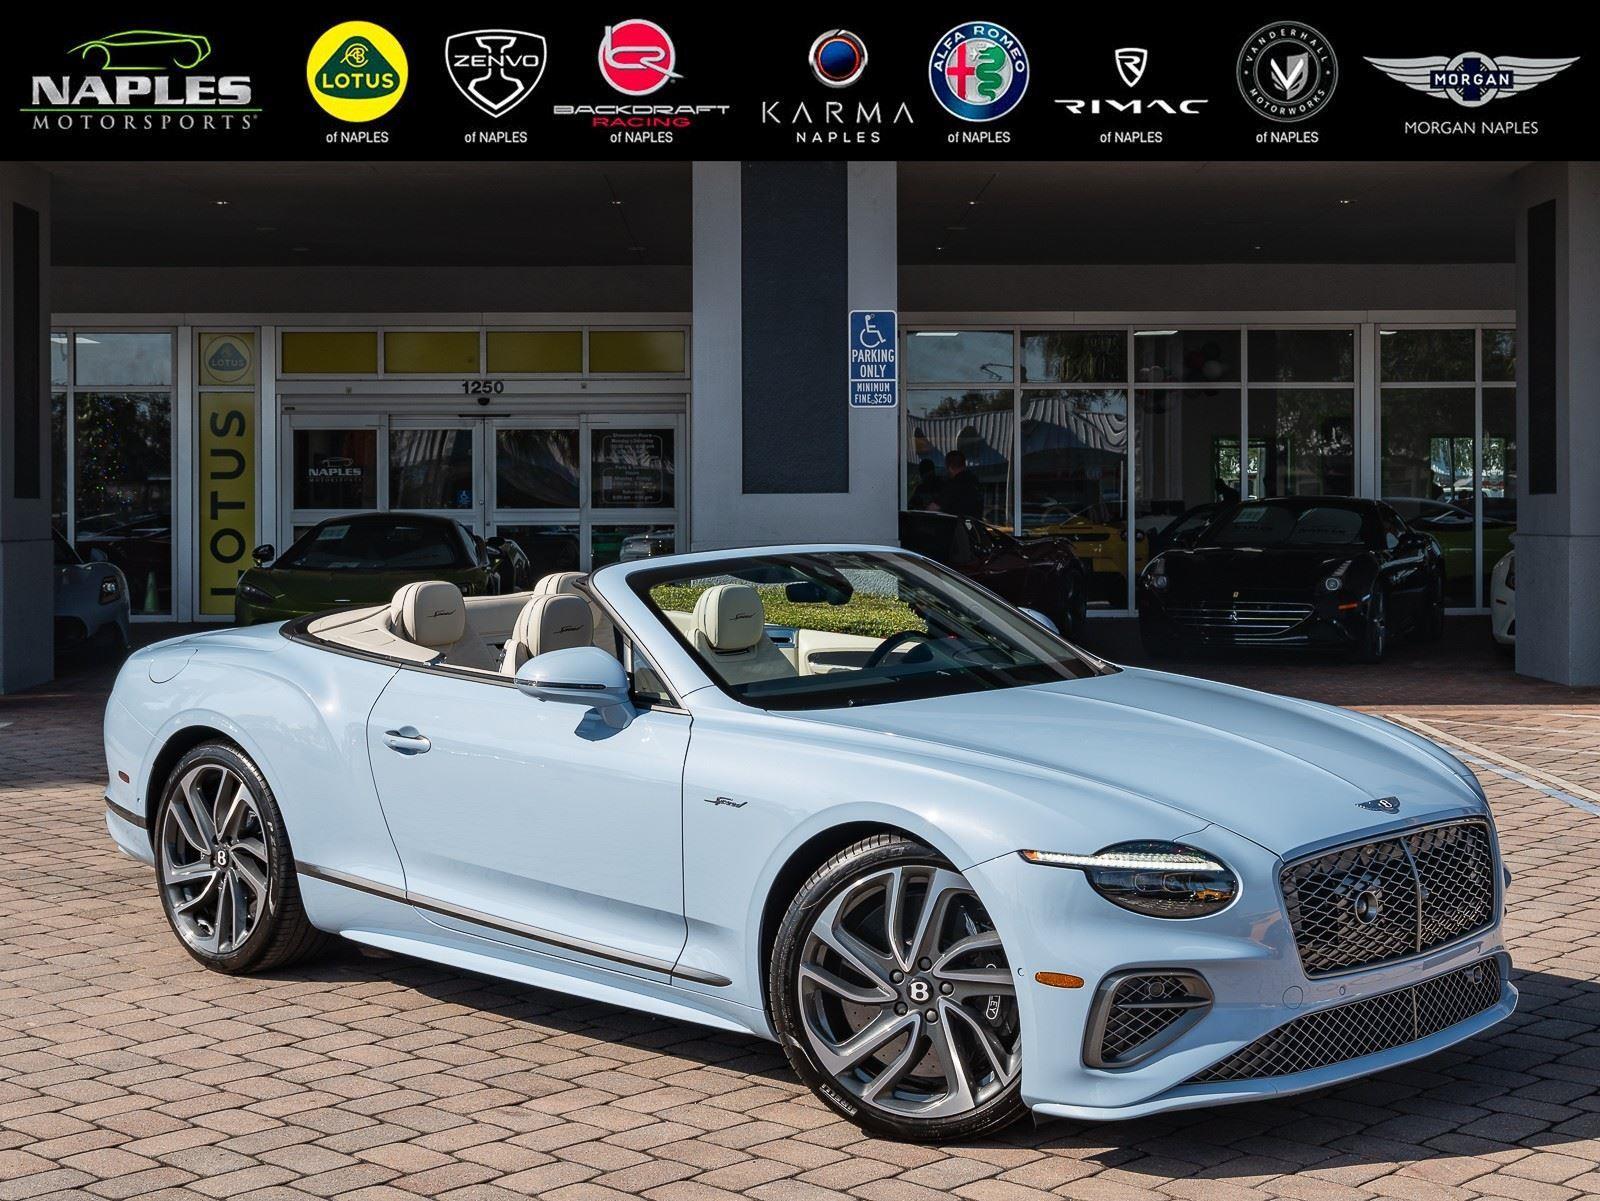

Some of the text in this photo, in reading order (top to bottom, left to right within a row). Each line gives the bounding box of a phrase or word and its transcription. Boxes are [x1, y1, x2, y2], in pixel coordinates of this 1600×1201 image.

[852, 349, 895, 363] PARKING
[211, 358, 245, 368] LOTUS
[860, 364, 887, 378] ONLY
[462, 381, 503, 394] 1250
[856, 382, 890, 392] MINIMUM
[854, 393, 892, 404] FINE $250
[308, 468, 361, 477] NAPLES
[210, 409, 246, 596] LOTUS
[910, 981, 930, 1002] B
